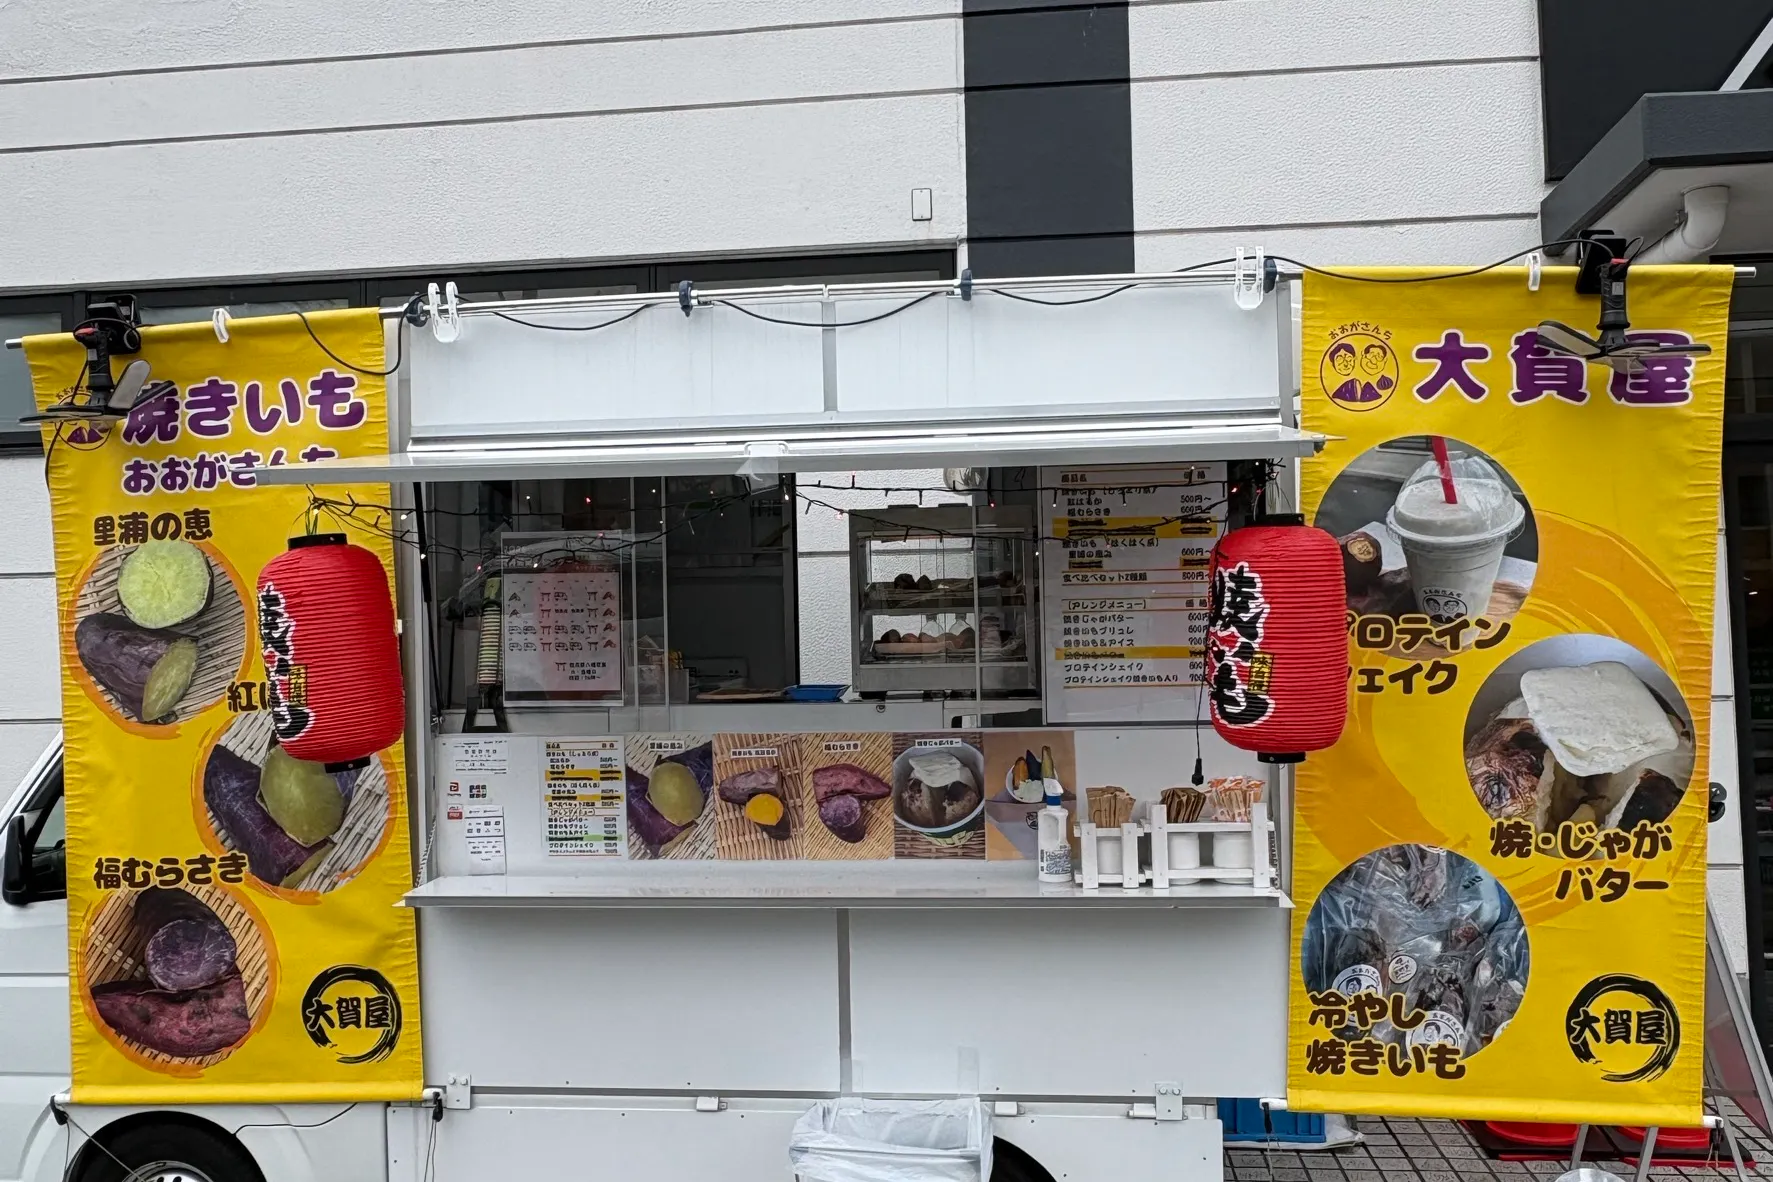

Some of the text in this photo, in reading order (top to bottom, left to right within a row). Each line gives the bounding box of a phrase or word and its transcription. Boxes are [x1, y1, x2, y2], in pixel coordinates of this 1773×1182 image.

[93, 508, 213, 546] 里浦の恵
[1347, 611, 1512, 653] ロテイン
[1348, 660, 1459, 696] ェイク
[1489, 821, 1673, 860] 焼・じゃが
[93, 853, 248, 890] 福むらさき
[1554, 866, 1670, 904] バター
[305, 995, 393, 1031] 大賀屋
[1307, 990, 1427, 1032] 冷やし
[1570, 1008, 1669, 1046] 大賀屋
[1305, 1038, 1467, 1080] 焼きいも
